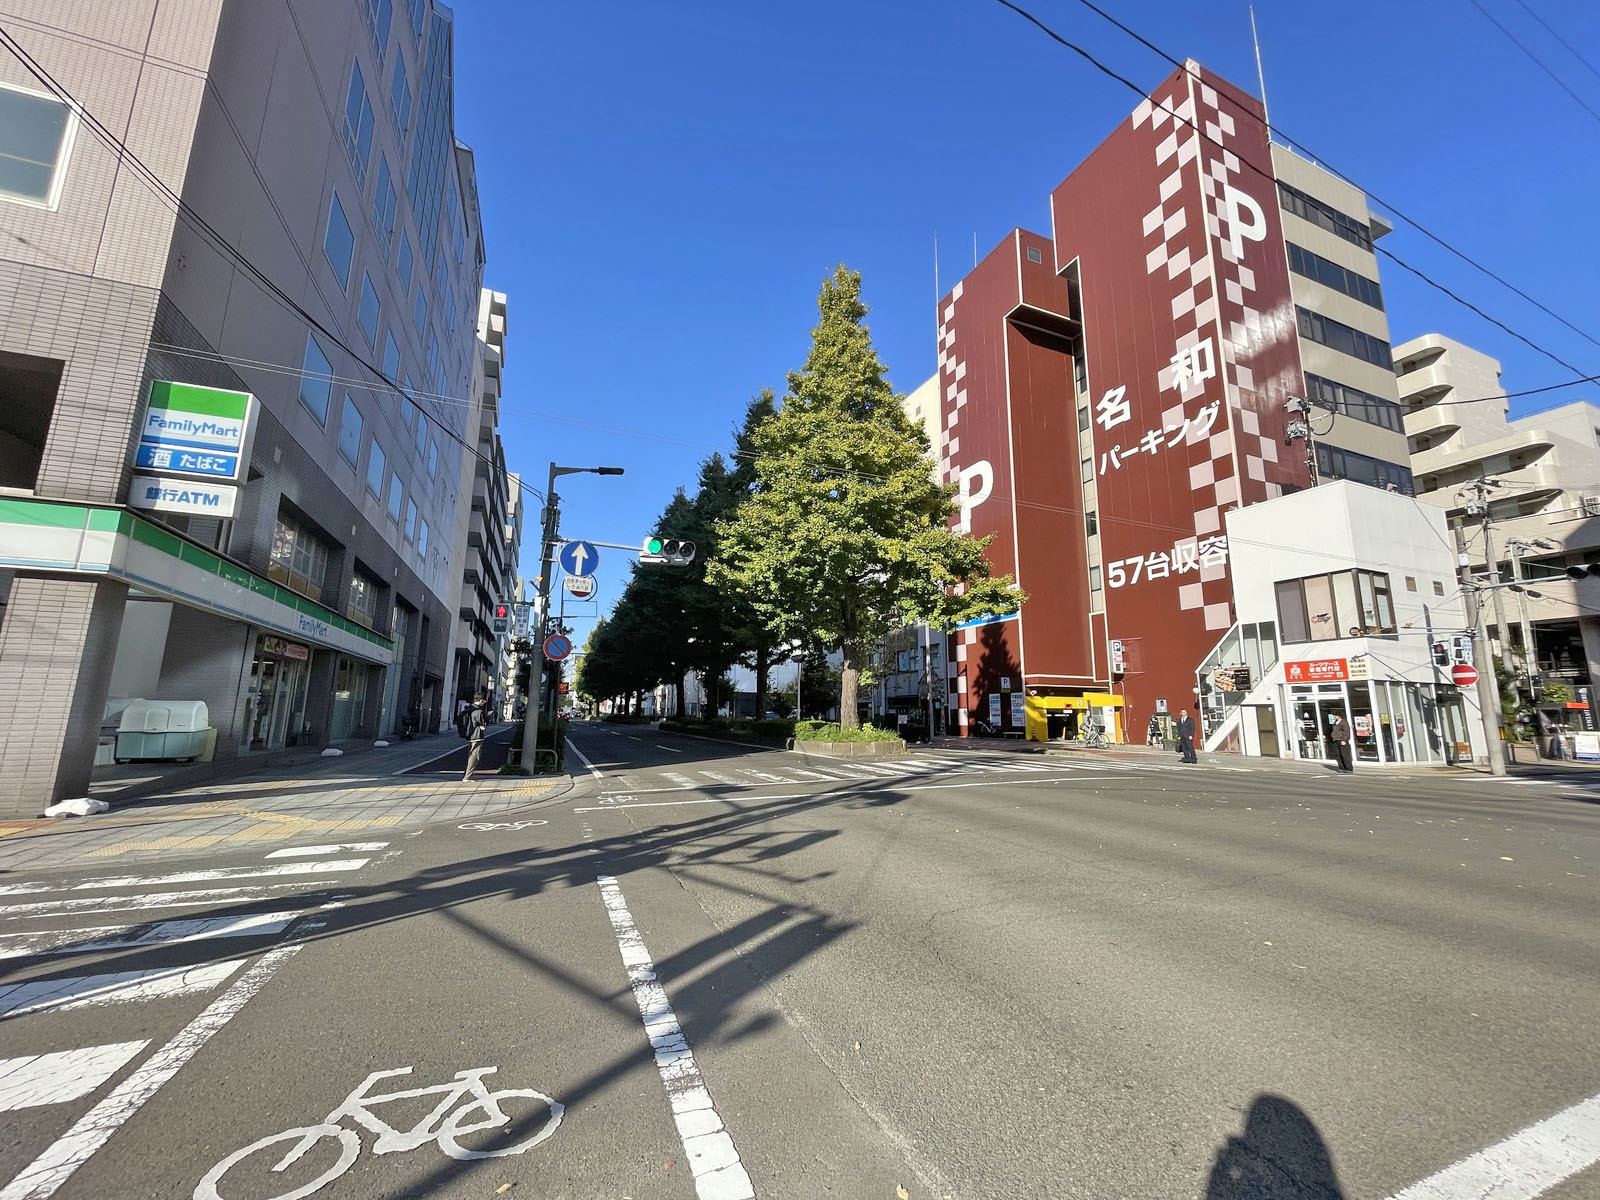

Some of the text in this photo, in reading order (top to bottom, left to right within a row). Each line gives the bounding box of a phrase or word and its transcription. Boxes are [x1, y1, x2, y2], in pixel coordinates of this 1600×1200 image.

[1223, 183, 1267, 260] P
[148, 415, 239, 438] FamilyMart
[1099, 399, 1221, 476] パーキング
[147, 447, 227, 472] 酒 たばこ
[145, 486, 220, 507] 銀行ATM
[958, 459, 994, 534] P
[1107, 534, 1229, 589] 57台収容
[298, 614, 328, 638] FamilyMart
